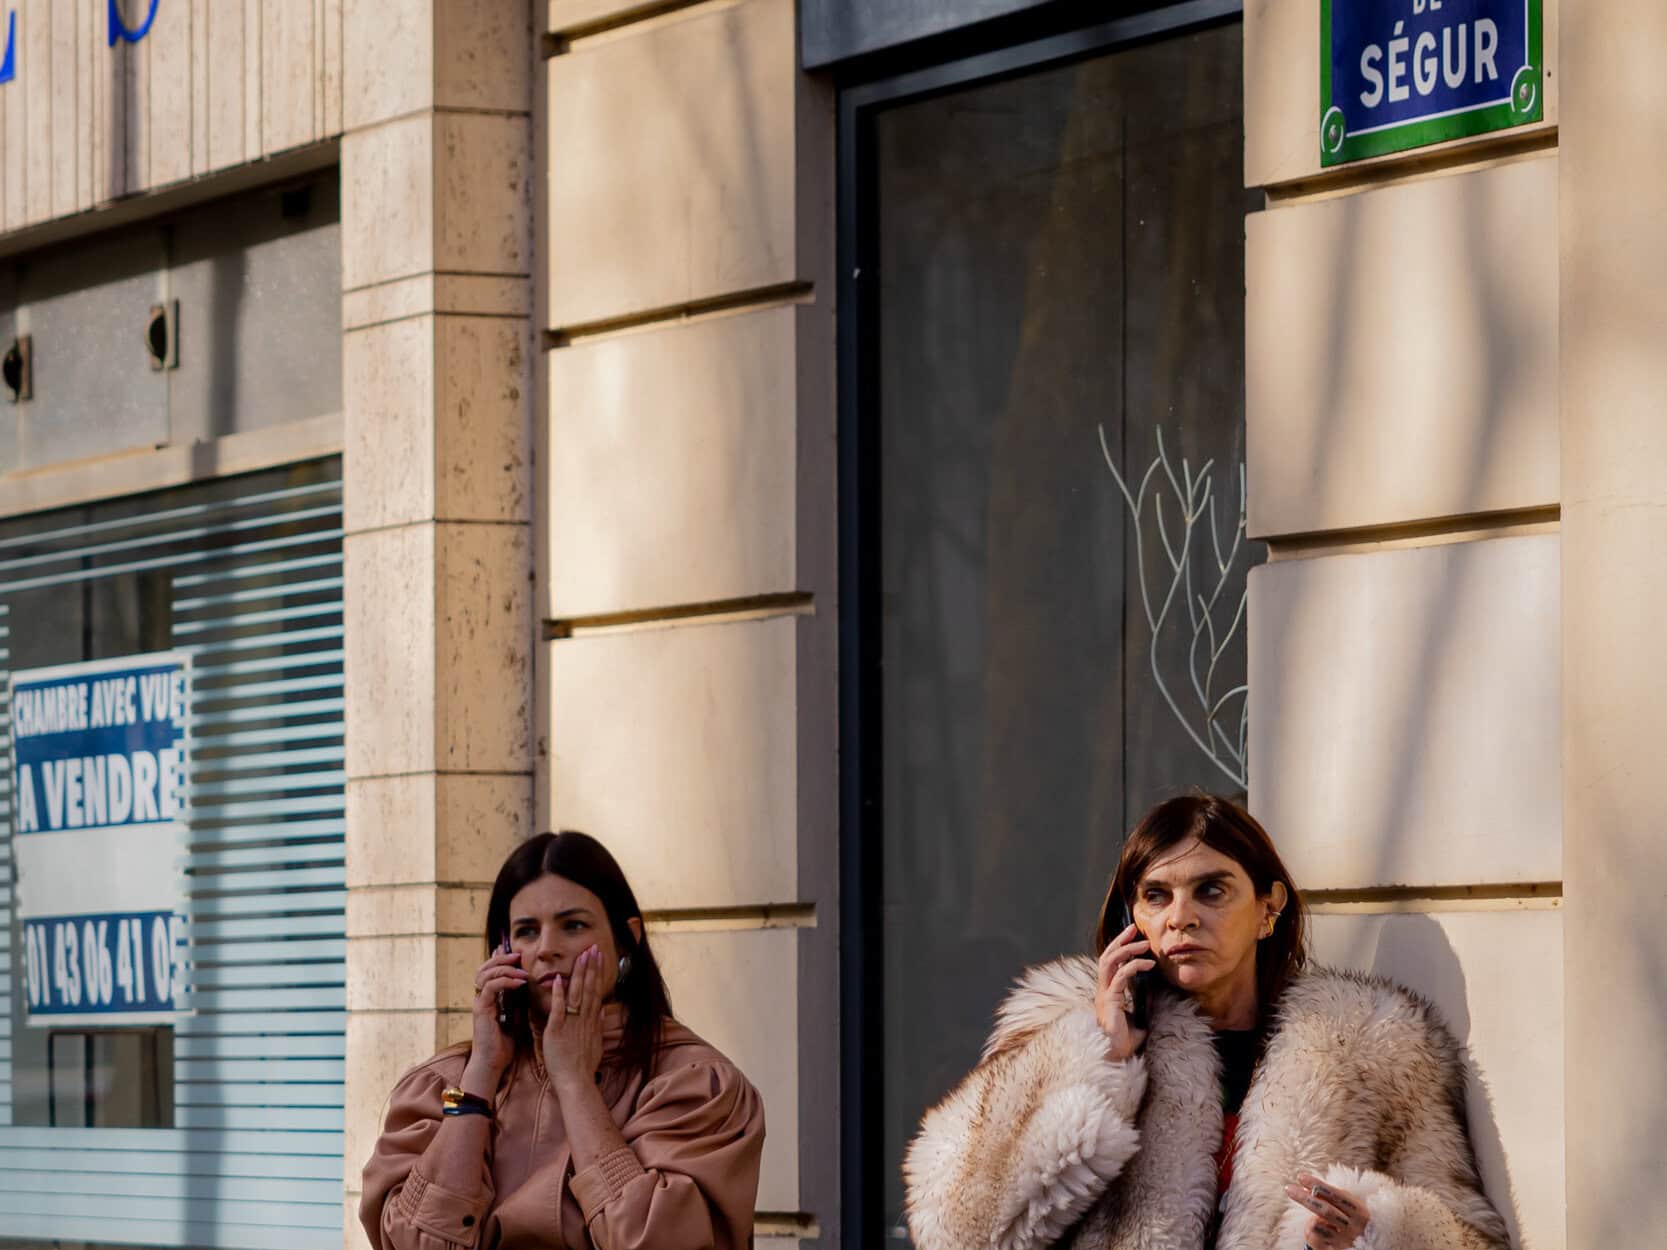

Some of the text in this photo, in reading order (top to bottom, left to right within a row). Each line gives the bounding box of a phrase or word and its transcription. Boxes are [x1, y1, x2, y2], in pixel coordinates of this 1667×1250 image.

[1360, 18, 1499, 108] SÉGUR
[15, 671, 181, 737] CHAMBRE AVEC VUE
[42, 748, 181, 829] VENDRE
[27, 924, 50, 1007] 01
[55, 921, 81, 1006] 43
[83, 920, 113, 1005] 06
[117, 918, 146, 1003] 41
